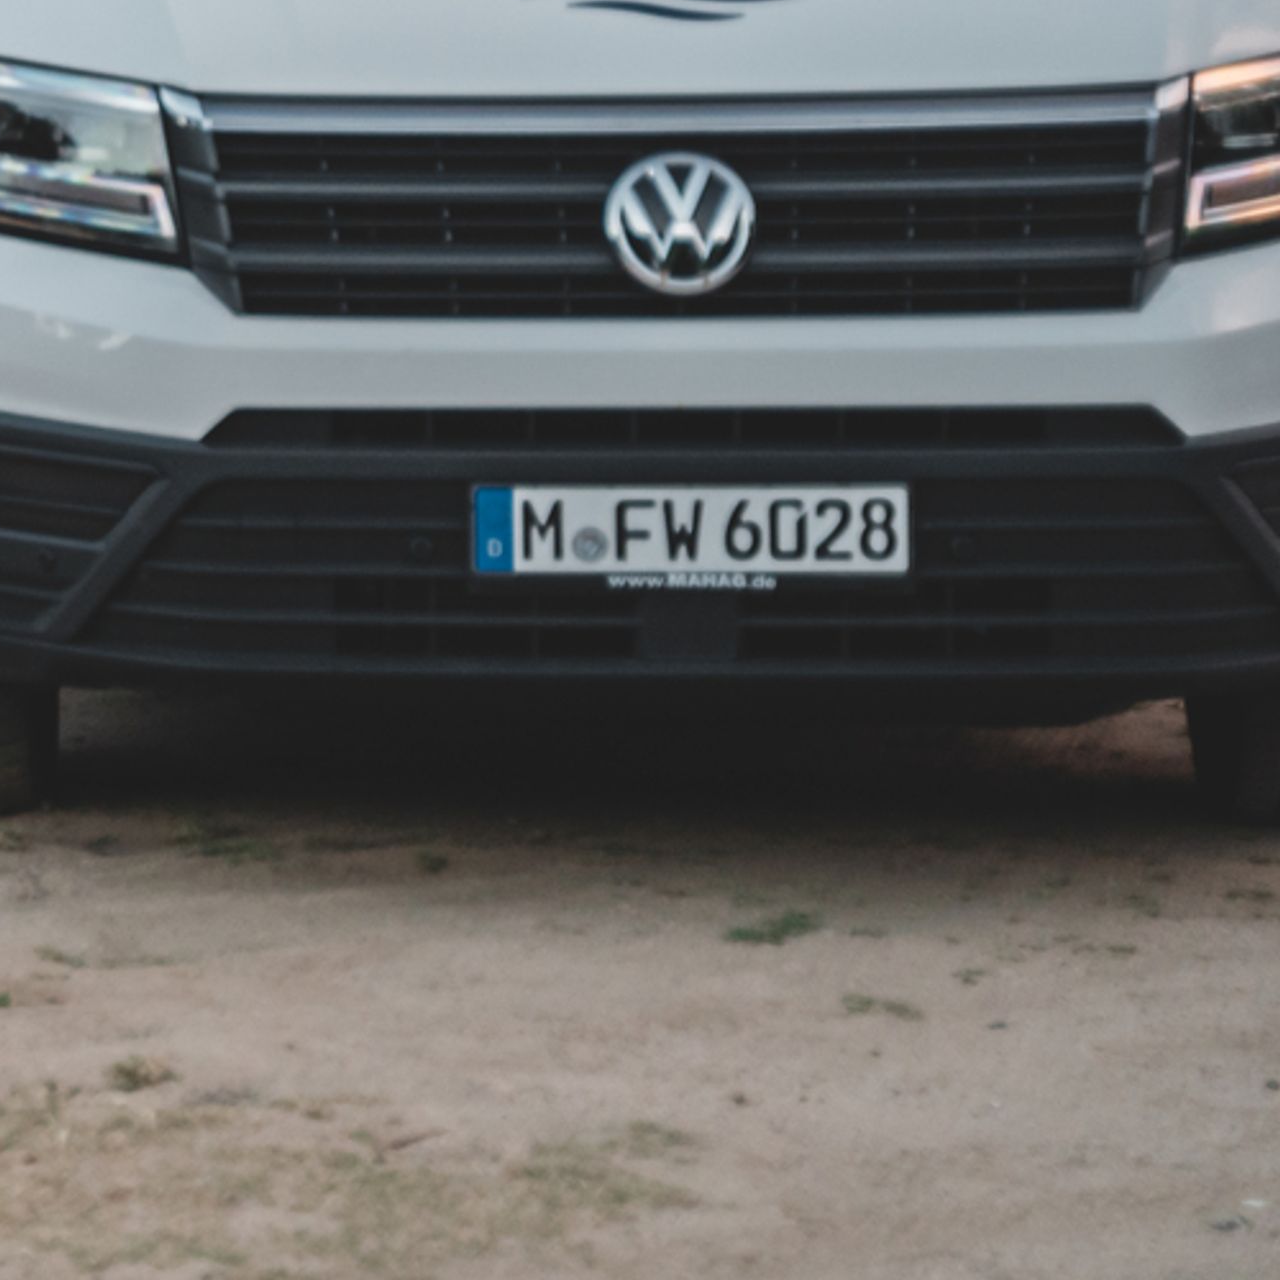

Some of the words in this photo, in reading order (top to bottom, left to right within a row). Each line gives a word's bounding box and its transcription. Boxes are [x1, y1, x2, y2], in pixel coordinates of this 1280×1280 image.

[608, 155, 752, 282] VW
[487, 538, 503, 558] D
[523, 499, 563, 560] M
[615, 499, 703, 560] FW
[725, 498, 898, 560] 6028
[608, 573, 777, 589] www.MAHAG.de
